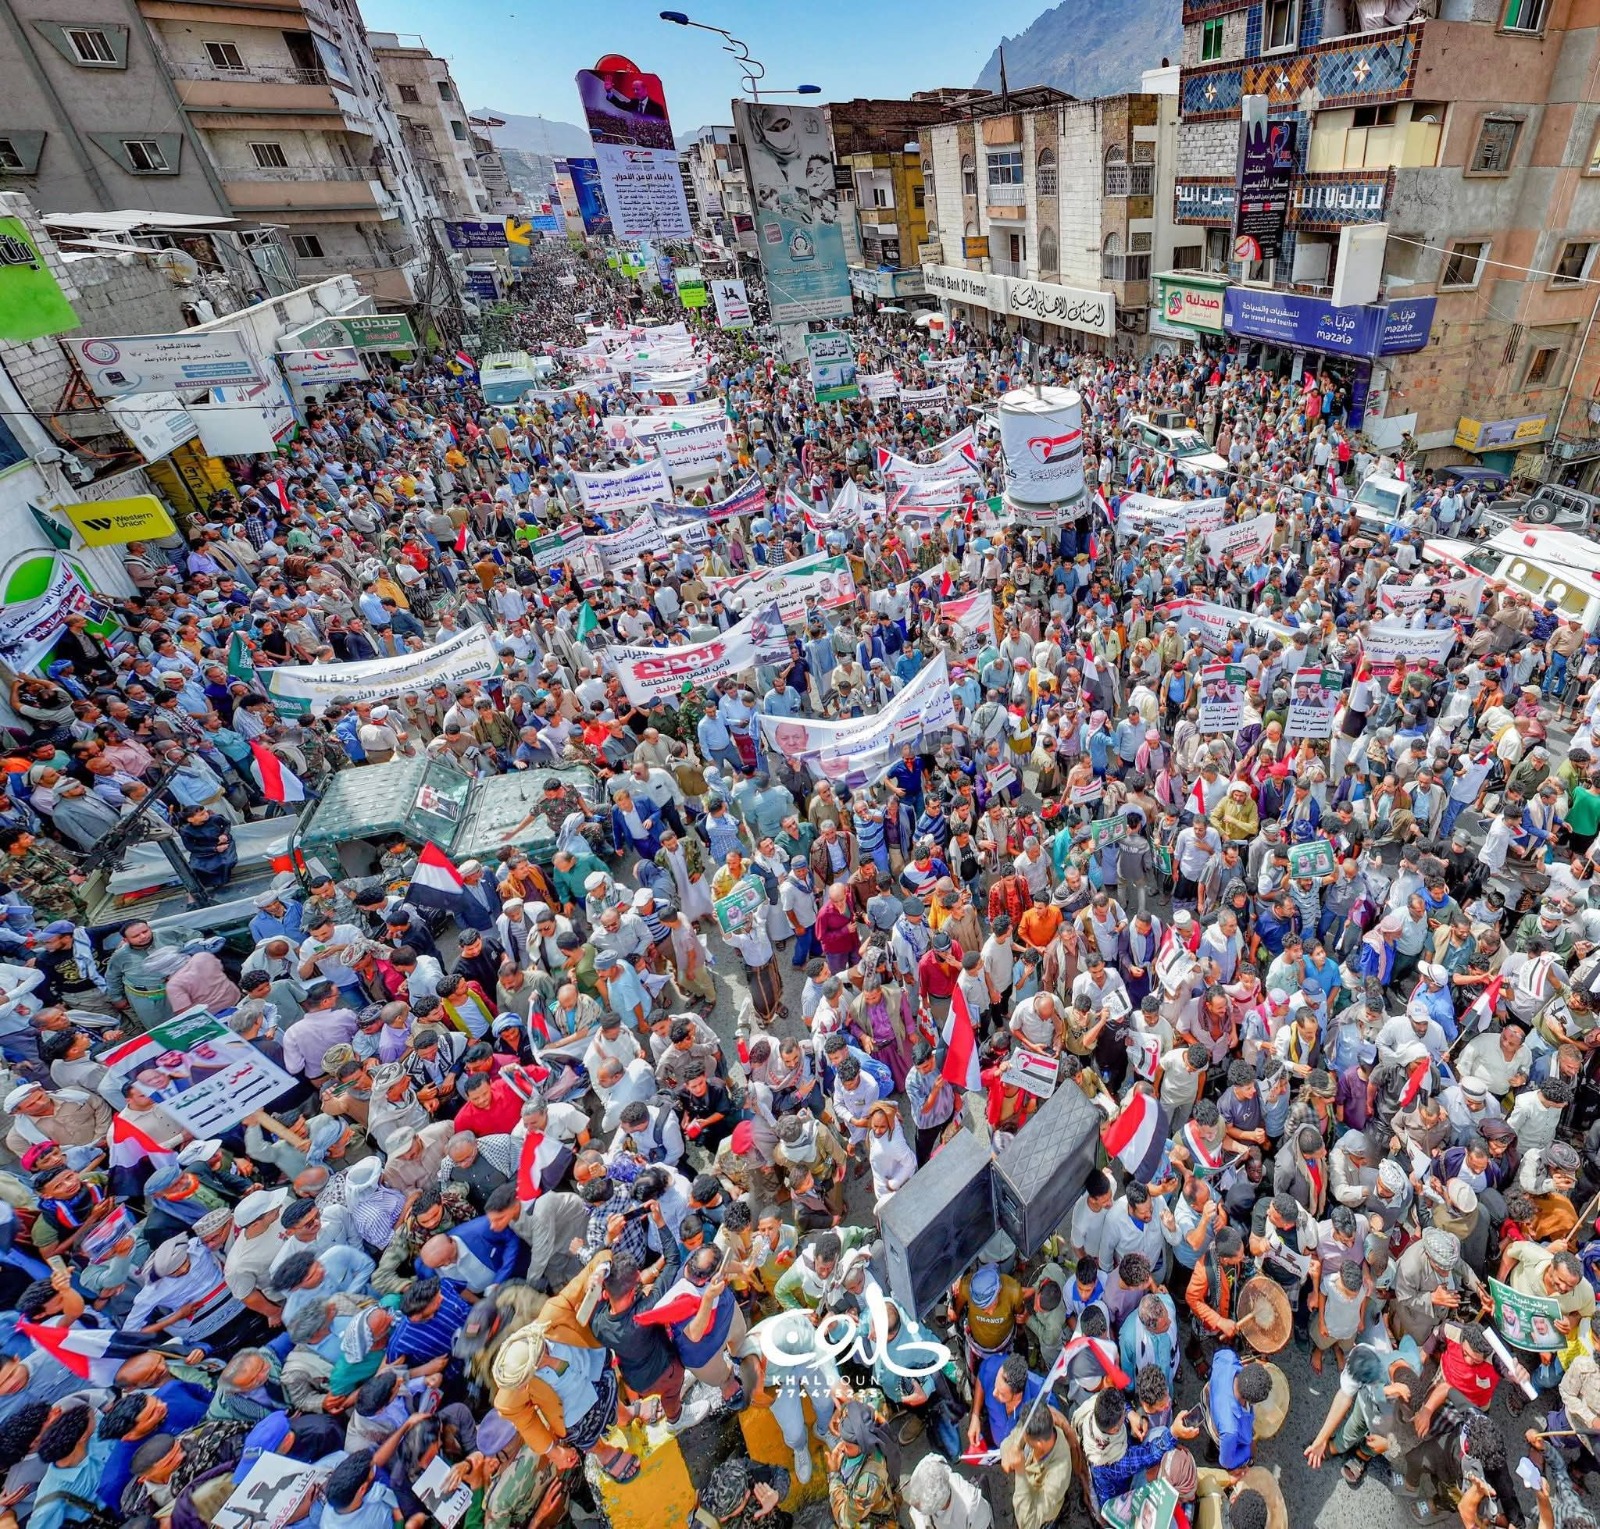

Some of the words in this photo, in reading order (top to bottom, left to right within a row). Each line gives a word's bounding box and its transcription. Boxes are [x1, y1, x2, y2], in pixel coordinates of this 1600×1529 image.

[926, 271, 946, 289] National
[947, 276, 960, 291] Bank
[961, 279, 968, 293] Of
[1186, 292, 1219, 309] صيدلية
[351, 319, 400, 331] صيدلية
[1251, 313, 1266, 322] travel
[1267, 316, 1276, 324] and
[703, 422, 720, 434] أبناء
[648, 428, 700, 444] المحافظات
[113, 512, 153, 522] Western
[117, 520, 146, 528] Union
[1187, 609, 1225, 626] القاهرة
[467, 634, 486, 647] دعم
[424, 640, 464, 663] المملكة
[643, 646, 715, 675] تهديد
[712, 660, 731, 672] لأمن
[451, 661, 491, 680] والمصير
[685, 667, 710, 680] اليمن
[641, 674, 685, 688] والمنطقة
[692, 671, 727, 684] والملاح
[380, 687, 399, 697] بين
[925, 691, 951, 710] قرارات
[925, 707, 954, 725] حماية
